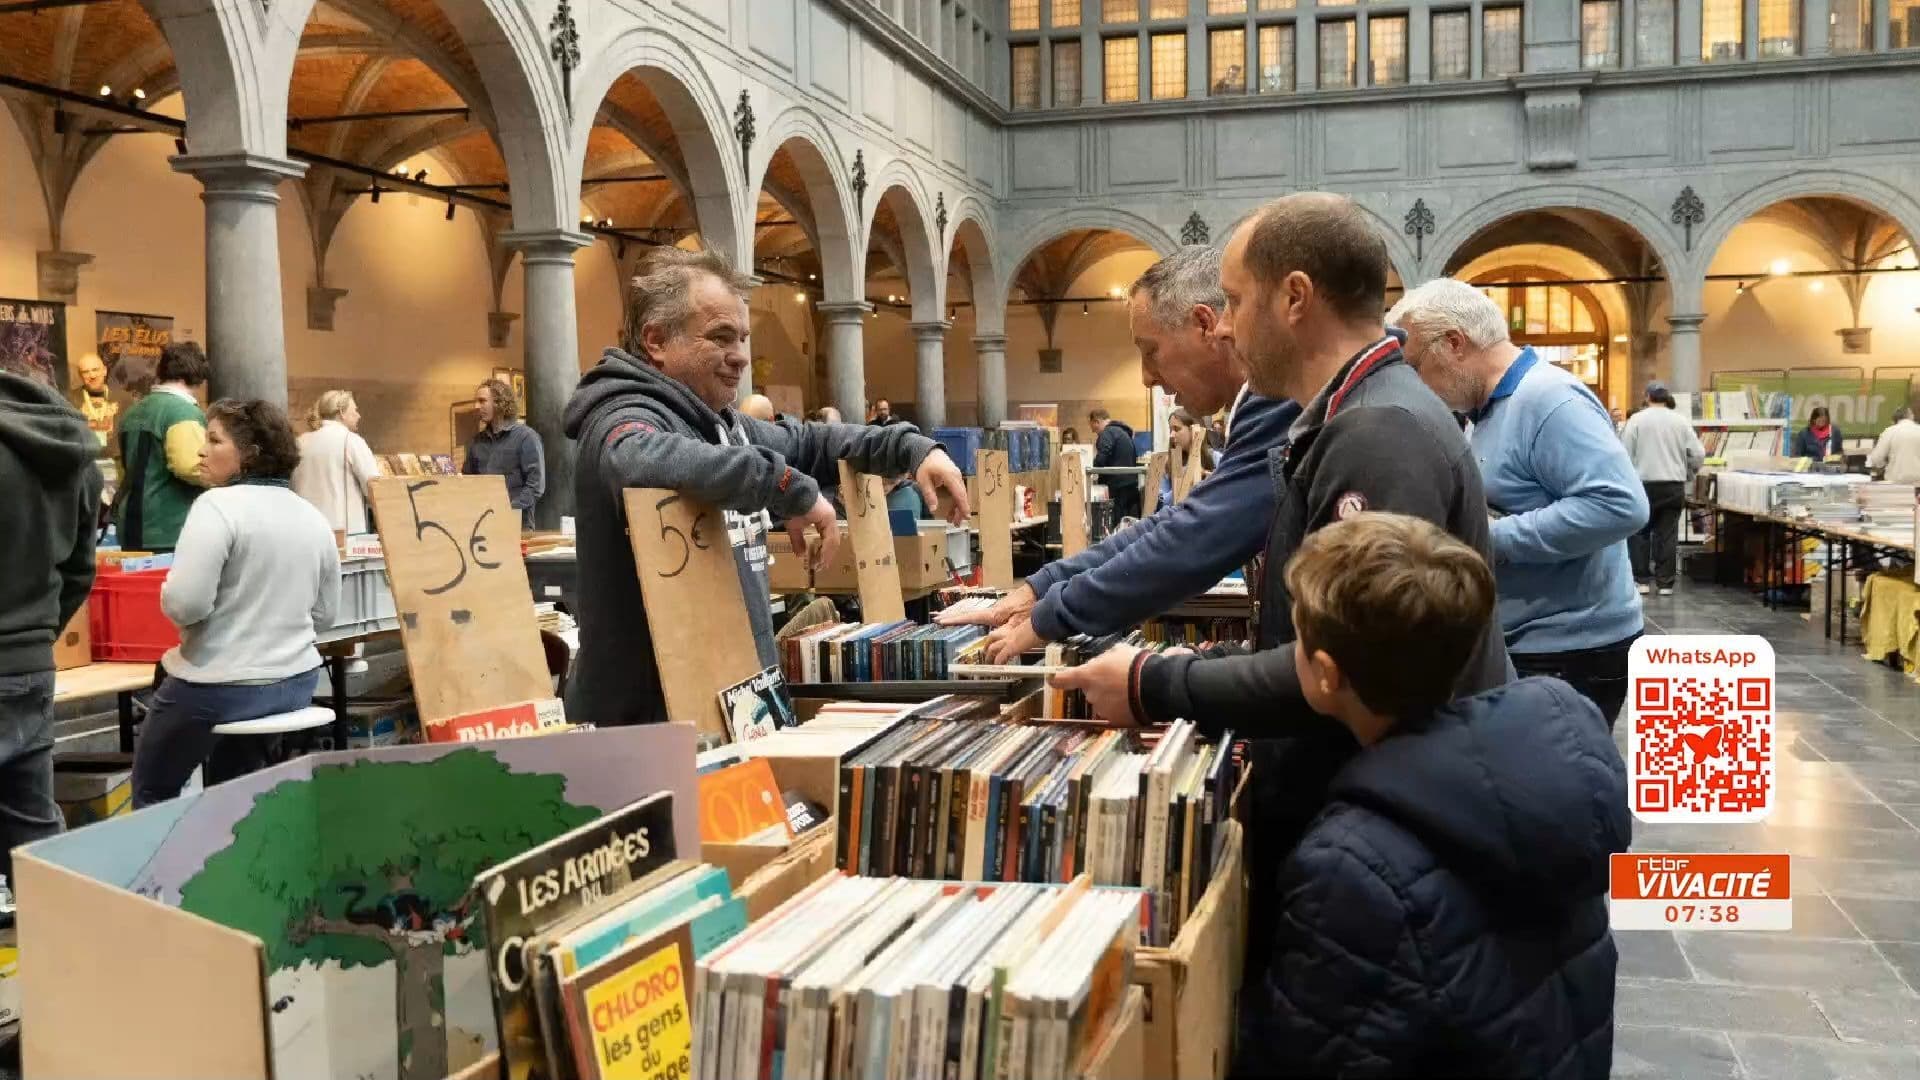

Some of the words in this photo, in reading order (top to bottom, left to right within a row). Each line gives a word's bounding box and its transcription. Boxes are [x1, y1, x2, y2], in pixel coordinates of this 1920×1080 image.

[406, 480, 503, 595] 5€
[656, 495, 710, 578] 5€
[518, 868, 560, 915] LES
[593, 965, 681, 1033] CHLORO
[602, 1033, 632, 1067] les
[637, 1003, 683, 1051] gens
[641, 1048, 661, 1073] du
